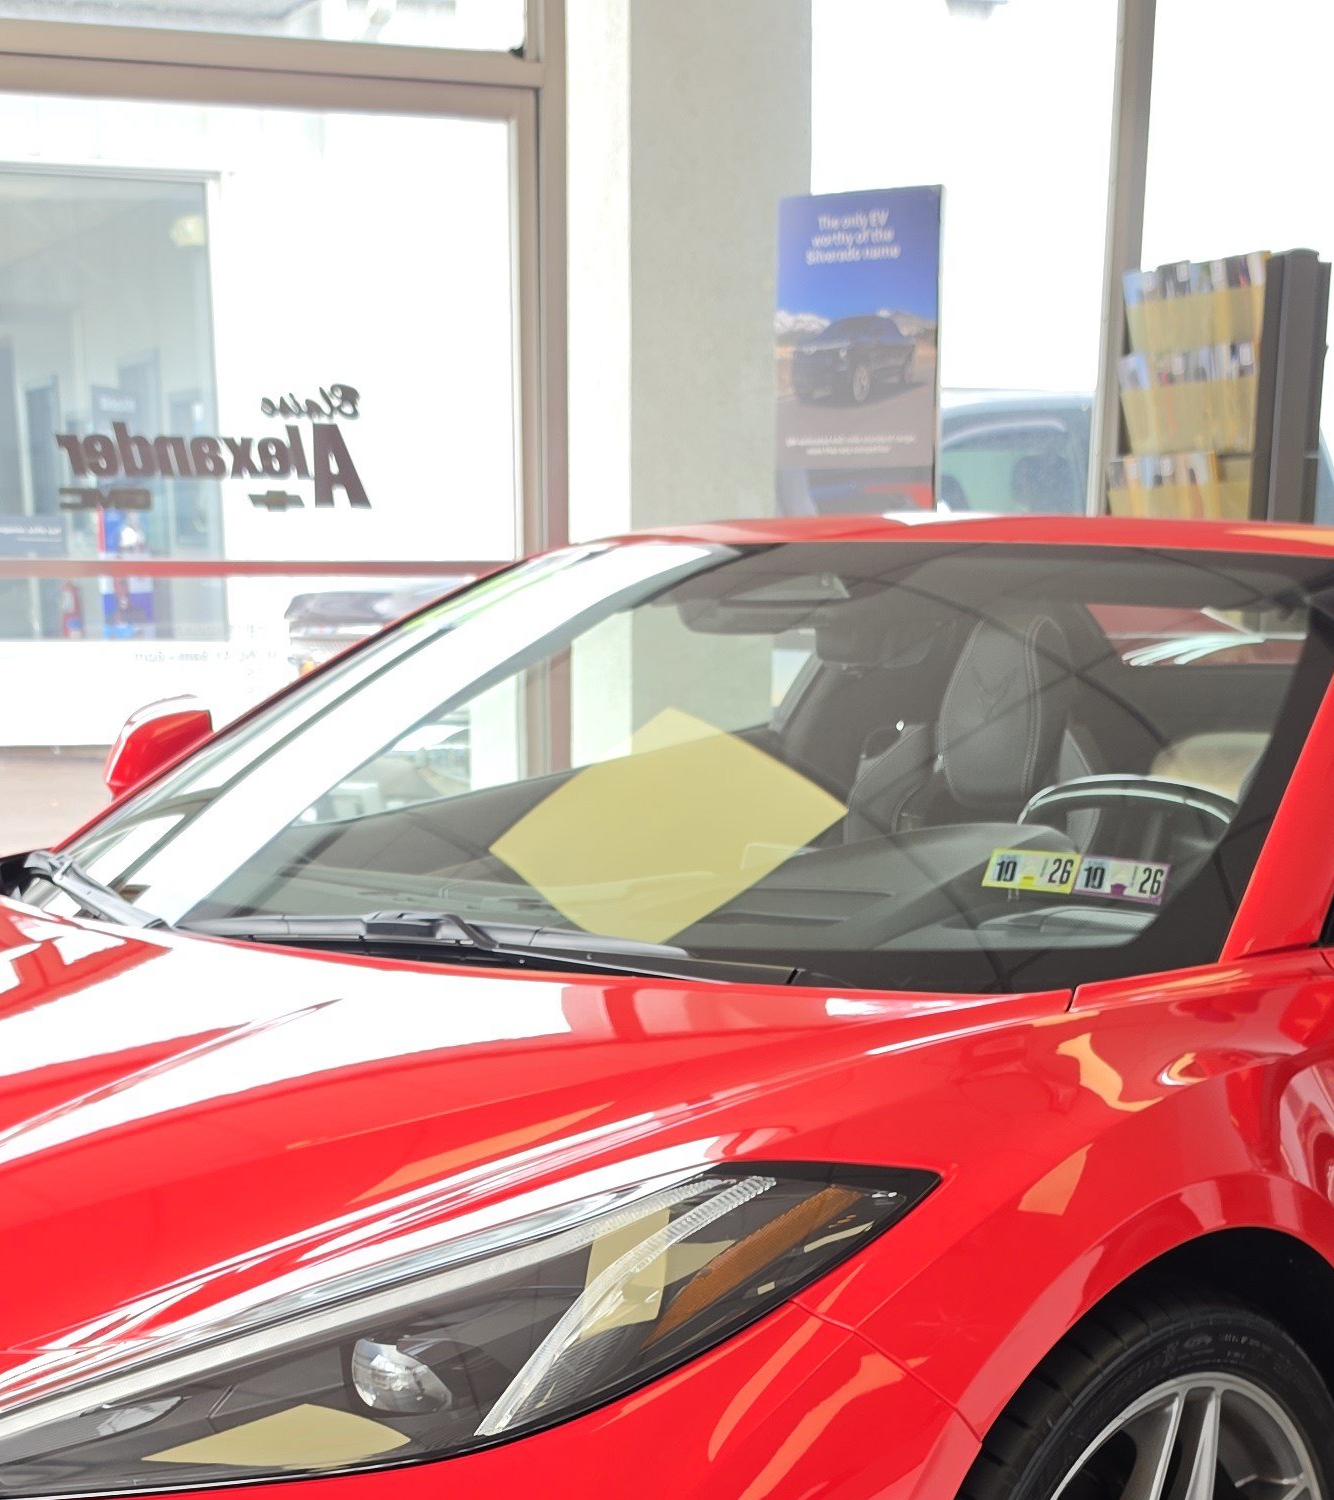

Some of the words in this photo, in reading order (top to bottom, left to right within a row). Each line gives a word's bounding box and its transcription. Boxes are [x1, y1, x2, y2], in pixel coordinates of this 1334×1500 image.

[818, 214, 840, 230] The
[842, 212, 867, 231] only
[868, 209, 889, 227] EV
[811, 230, 854, 248] worthy
[856, 229, 869, 244] of
[871, 228, 895, 243] the
[805, 247, 861, 265] Silverado
[863, 245, 901, 260] name
[997, 860, 1017, 882] 10
[1048, 858, 1074, 885] 26
[1084, 866, 1105, 889] 10
[1138, 867, 1164, 896] 26
